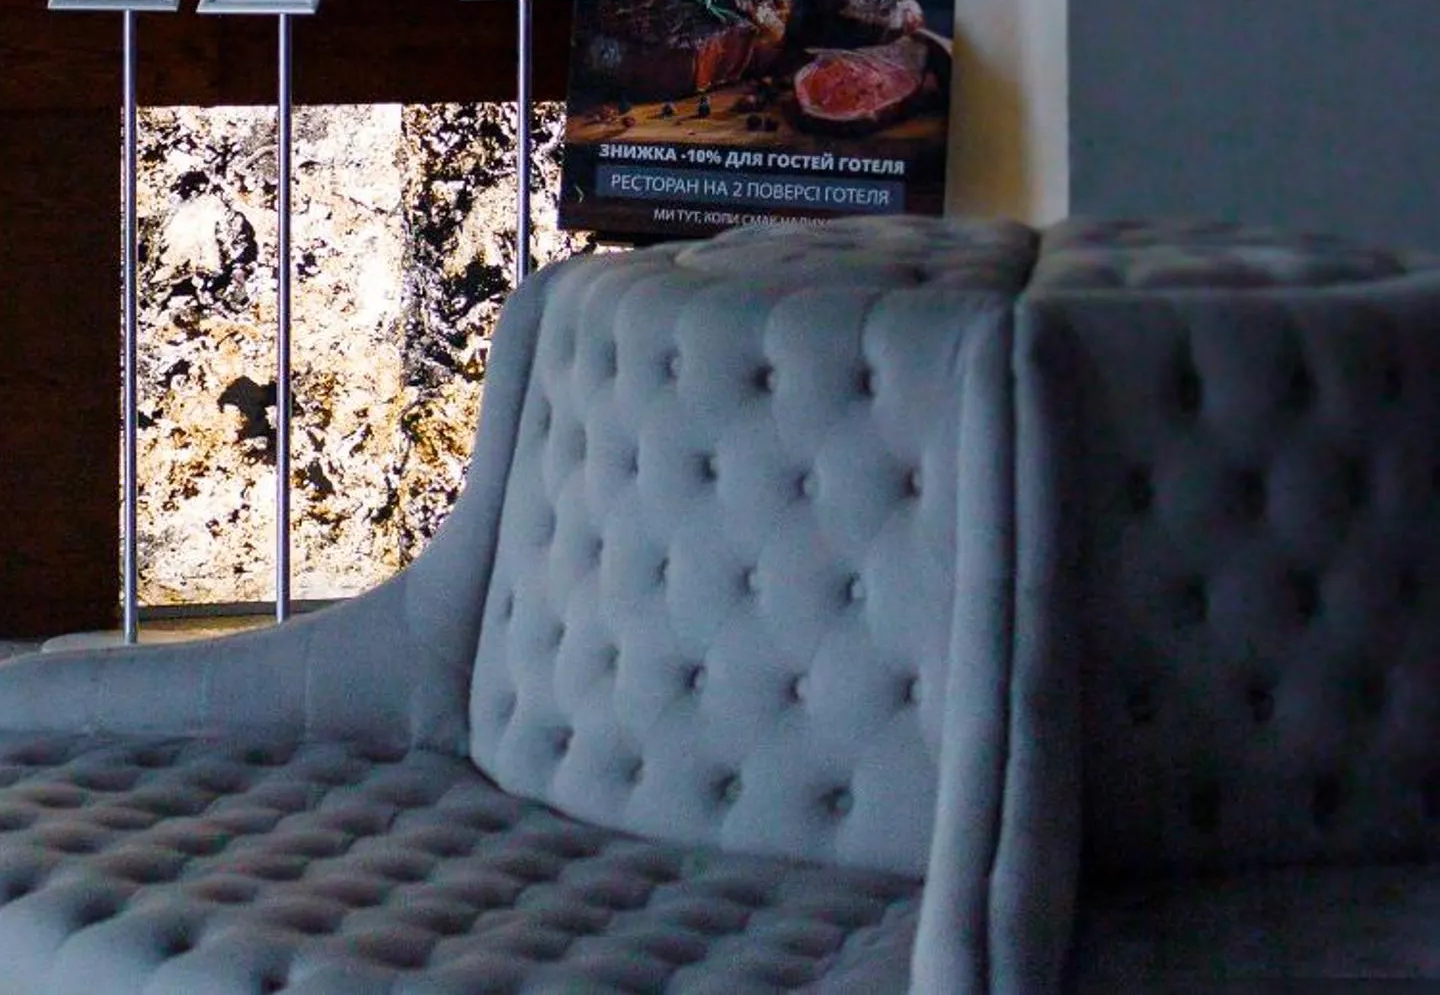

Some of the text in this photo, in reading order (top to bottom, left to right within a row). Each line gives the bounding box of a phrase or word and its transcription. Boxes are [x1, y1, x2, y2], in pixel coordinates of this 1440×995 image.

[599, 144, 906, 176] ЗНИЖКА -10% ДЛЯ ГОСТЕЙ ГОТЕЛЯ
[611, 174, 890, 205] РЕСТОРАН НА 2 ПОВЕРСІ ГОТЕЛЯ
[653, 209, 675, 221] МИ
